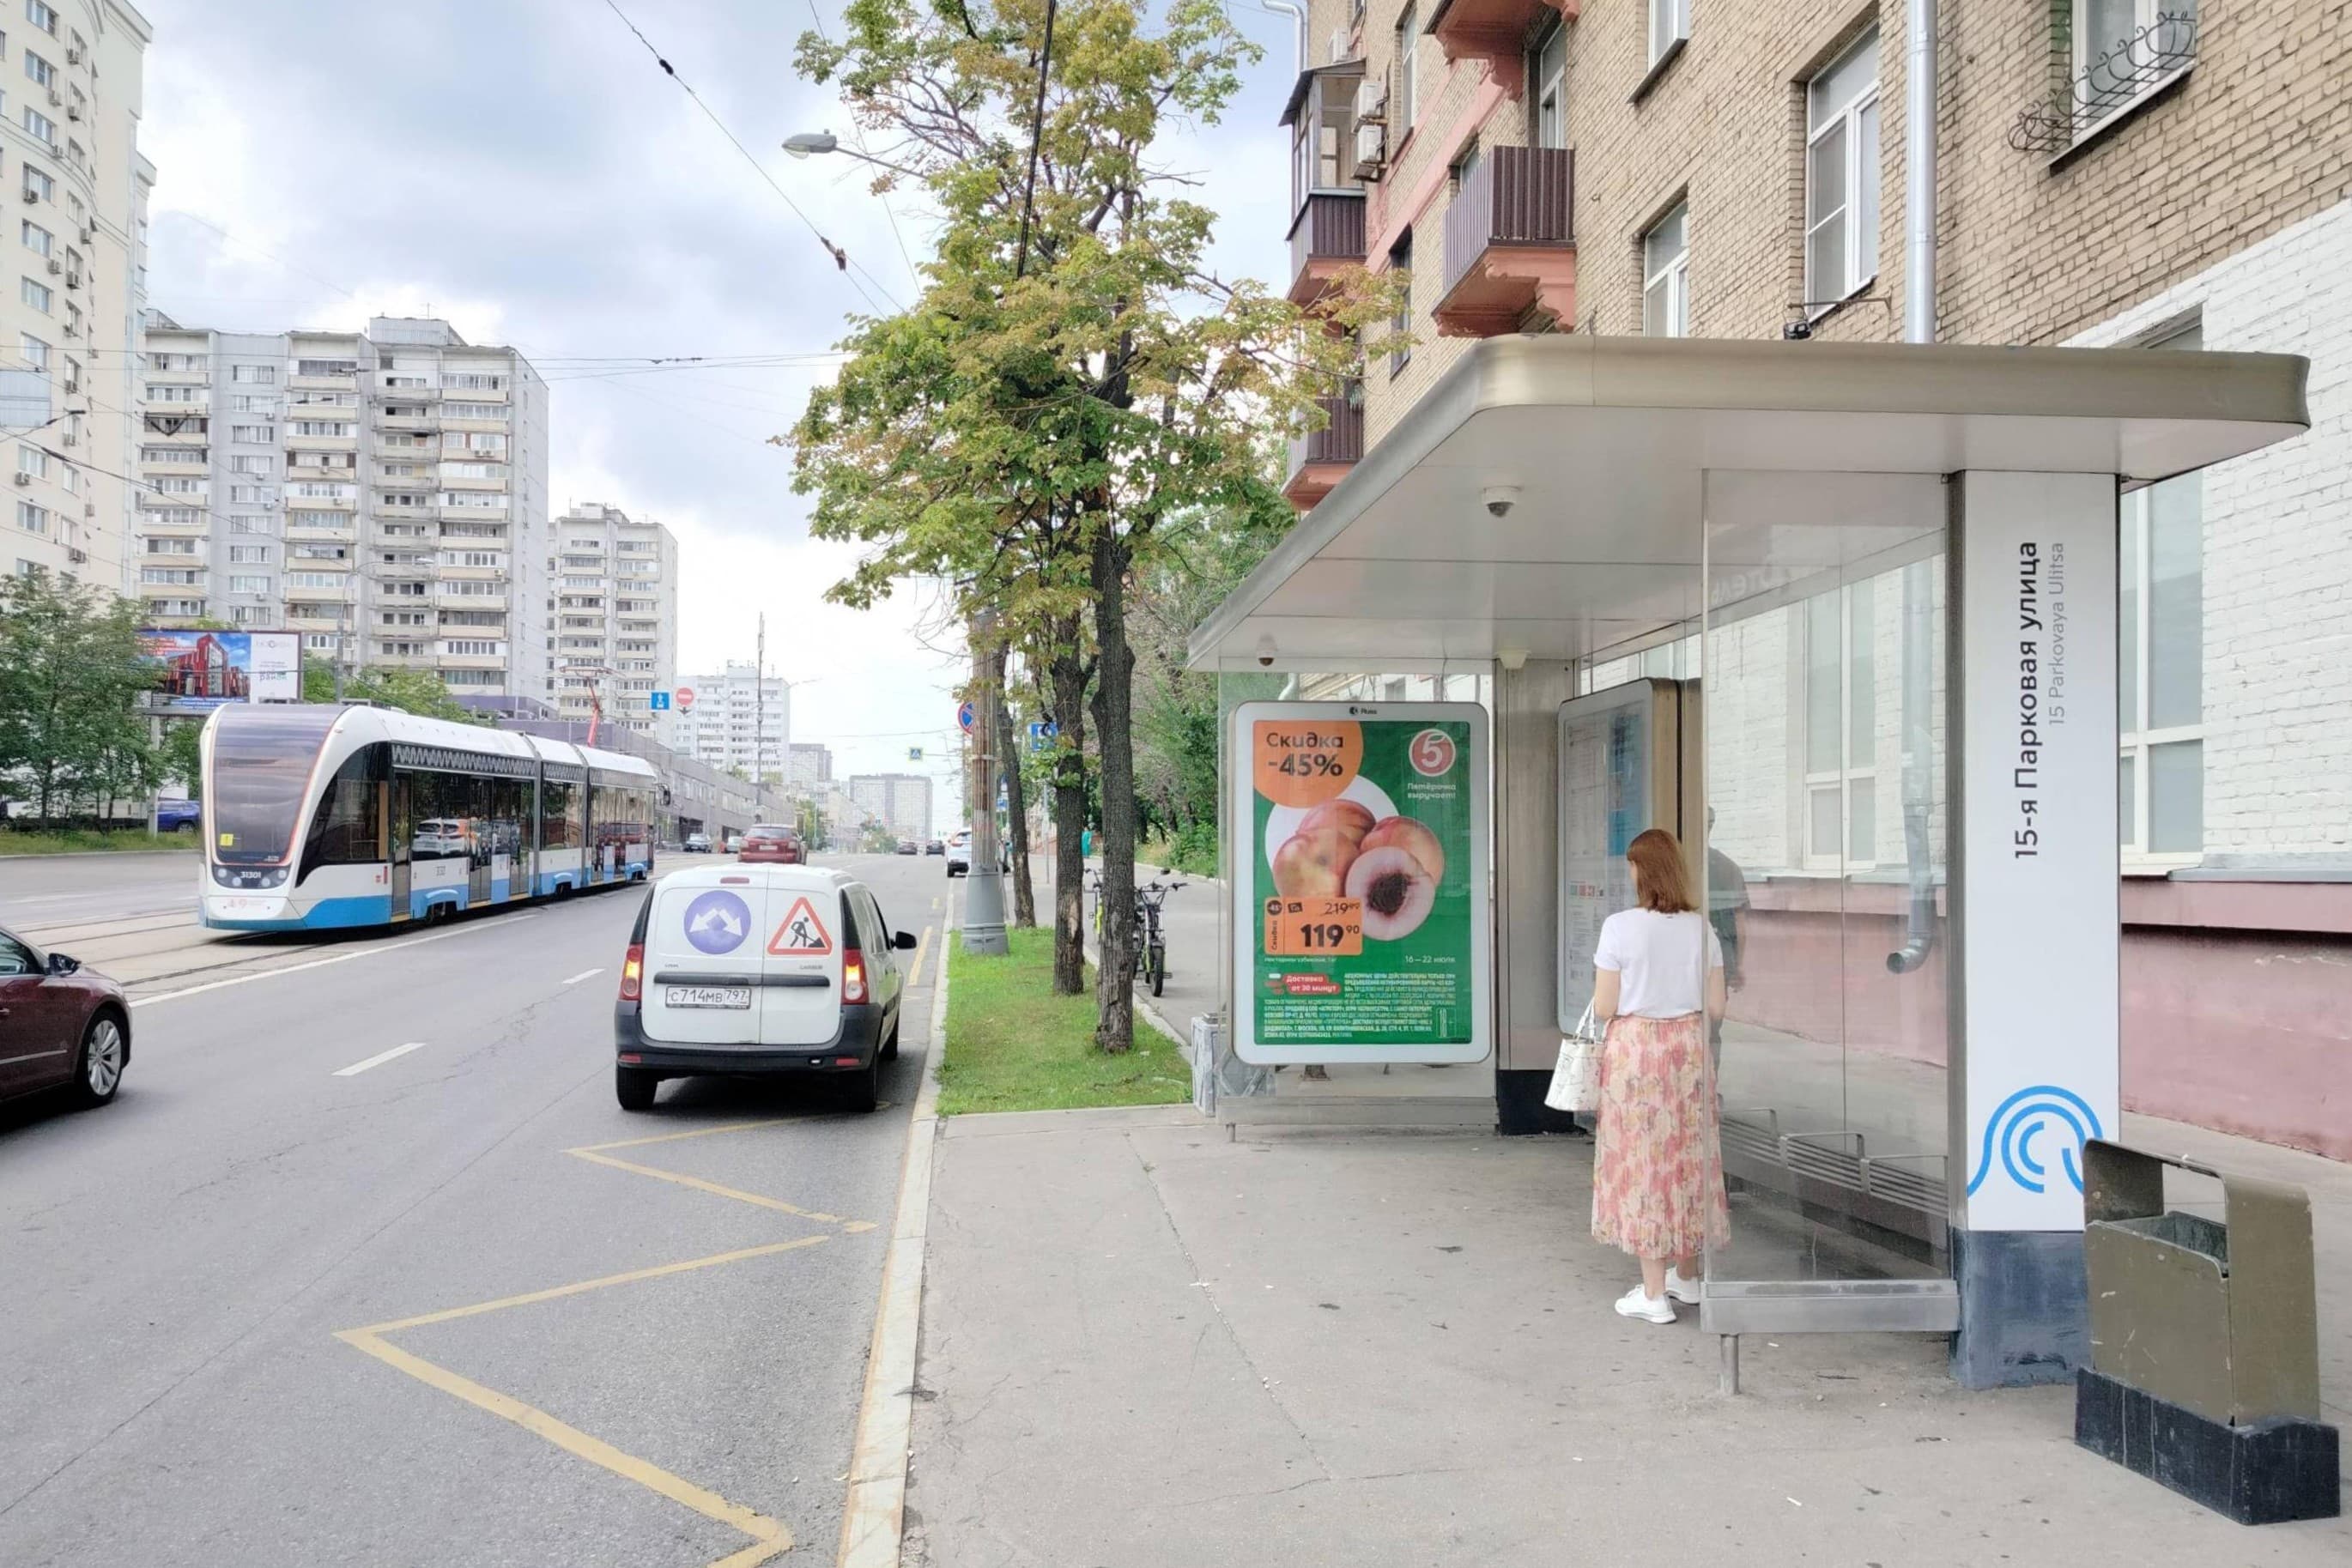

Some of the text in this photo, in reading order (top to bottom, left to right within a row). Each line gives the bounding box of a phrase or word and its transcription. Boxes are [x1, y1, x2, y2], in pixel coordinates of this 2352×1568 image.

[2047, 542, 2068, 726] 15 Parkovaya Ulitsa
[2015, 542, 2043, 859] 15-я Парковая улица
[1266, 732, 1343, 749] Скидка
[1422, 733, 1446, 768] 5
[1268, 754, 1343, 777] -45%
[1300, 923, 1344, 947] 119
